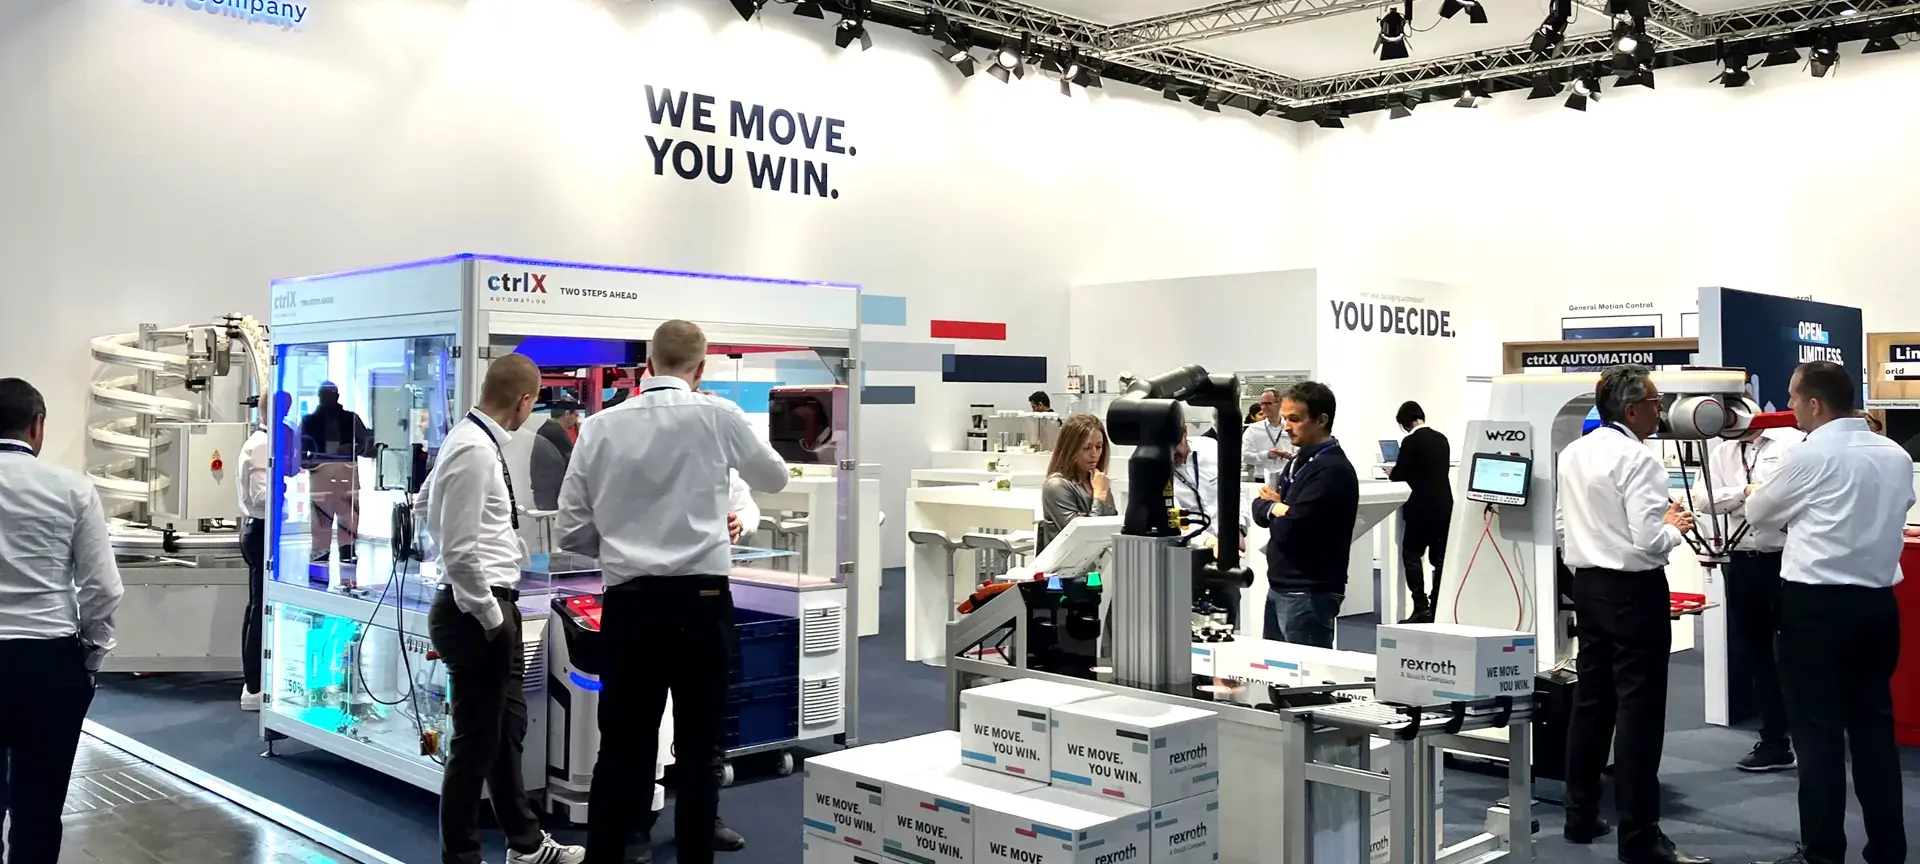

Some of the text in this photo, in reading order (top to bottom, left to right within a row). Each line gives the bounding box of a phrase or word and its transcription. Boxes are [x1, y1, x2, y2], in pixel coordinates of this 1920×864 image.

[199, 0, 307, 22] mpany
[644, 84, 856, 157] WE MOVE.
[644, 135, 839, 199] YOU WIN.
[488, 272, 547, 293] ctrlX
[490, 296, 546, 304] AUTOMATION
[560, 287, 638, 300] TWO STEPS AHEAD
[1625, 301, 1653, 309] Control
[1330, 300, 1456, 338] YOU DECIDE.
[1798, 321, 1824, 341] OPEN.
[1526, 352, 1653, 365] ctrlX AUTOMATION
[1485, 430, 1526, 441] WYZO
[1400, 657, 1456, 676] rexroth
[1486, 665, 1520, 678] WE MOVE.
[1499, 679, 1530, 692] YOU WIN.
[973, 723, 1024, 743] WE MOVE.
[993, 741, 1040, 762] YOU WIN.
[1067, 743, 1123, 765] WE MOVE.
[1169, 742, 1207, 766] rexroth
[1089, 762, 1141, 785] YOU WIN.
[816, 793, 862, 815] WE MOVE.
[833, 812, 876, 834] YOU WIN.
[897, 815, 947, 839] WE MOVE.
[1169, 821, 1207, 846] rexroth
[916, 835, 963, 860] YOU WIN.
[990, 842, 1007, 857] WE
[1095, 843, 1136, 864] rexroth
